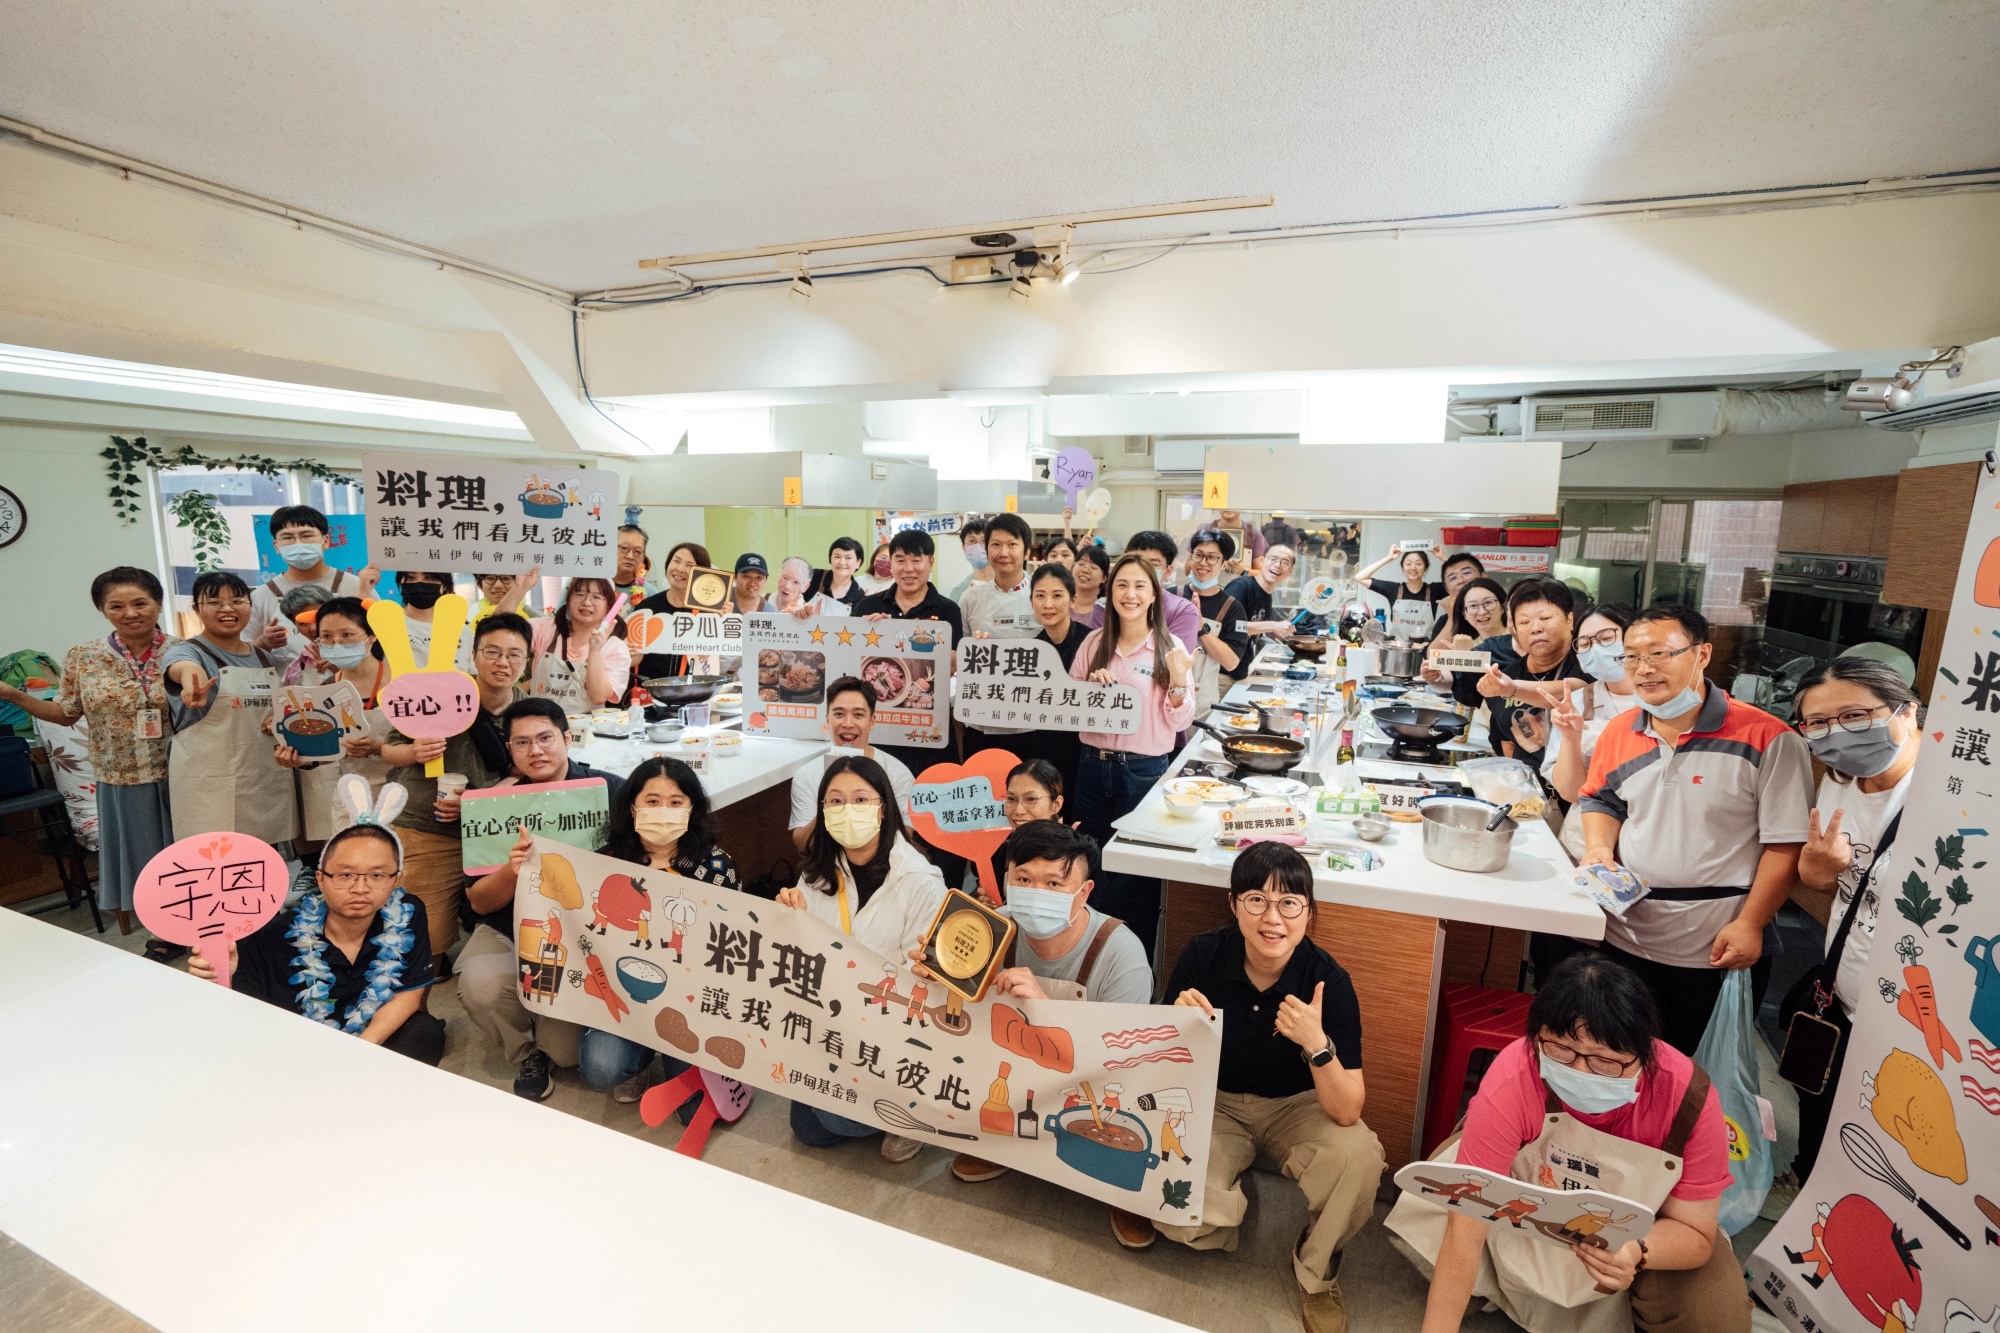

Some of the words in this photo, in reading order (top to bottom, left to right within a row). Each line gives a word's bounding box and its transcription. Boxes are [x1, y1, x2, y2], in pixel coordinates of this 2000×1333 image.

[1057, 456, 1093, 484] Ryan
[1211, 485, 1219, 499] A
[3, 509, 14, 521] 3
[380, 517, 607, 548] 讓我們看見彼此
[384, 546, 604, 568] 第一屆伊甸會所廚藝大賽
[673, 616, 742, 639] 伊心會
[672, 642, 694, 652] Eden
[695, 643, 720, 653] Heart
[721, 644, 742, 653] Club
[388, 695, 442, 719] 宜心
[962, 682, 1133, 710] 讓我們看見彼此
[962, 707, 1130, 730] 第一屆伊甸會所廚藝大賽
[1224, 817, 1295, 831] 評審吃完先別走
[158, 861, 276, 921] 宇恩
[700, 986, 972, 1112] 讓我們看見彼此
[788, 1069, 859, 1105] 伊甸基金會
